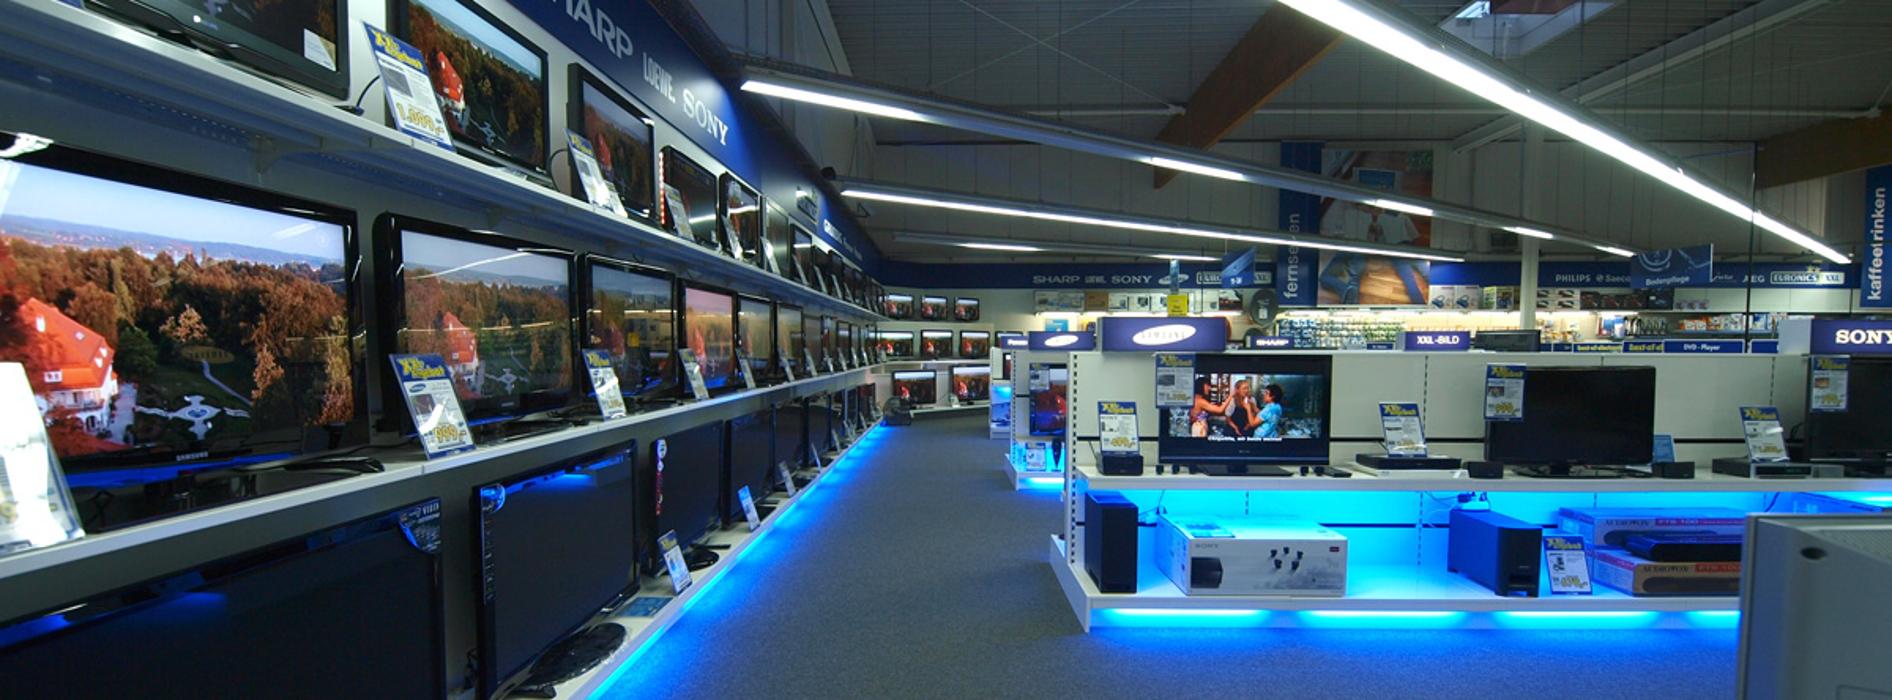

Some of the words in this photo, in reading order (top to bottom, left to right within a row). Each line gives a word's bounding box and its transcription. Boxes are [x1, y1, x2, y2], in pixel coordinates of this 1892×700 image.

[683, 88, 729, 146] SONY
[1282, 213, 1300, 299] fernseen
[1032, 275, 1081, 284] SHARP
[1111, 275, 1152, 284] SONY
[1555, 274, 1591, 282] PHILIPS
[1772, 274, 1817, 282] EURONICS
